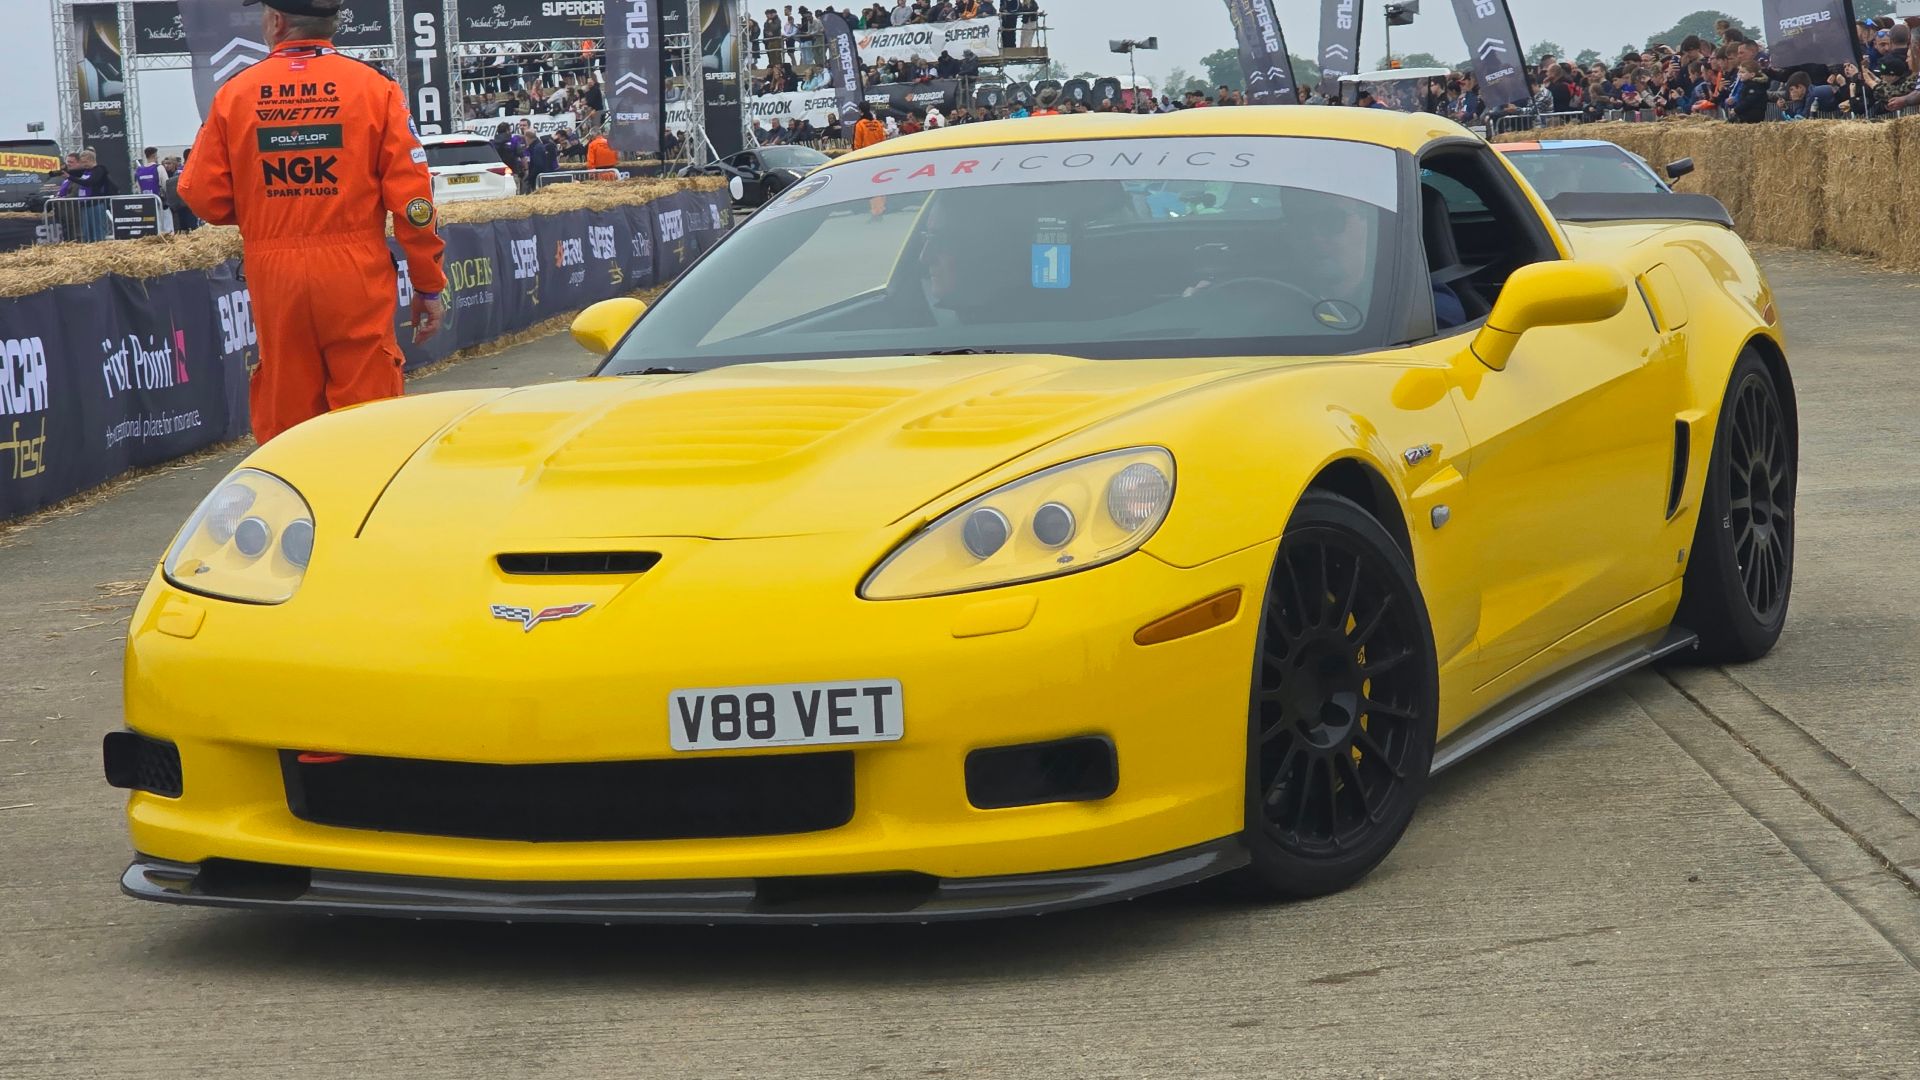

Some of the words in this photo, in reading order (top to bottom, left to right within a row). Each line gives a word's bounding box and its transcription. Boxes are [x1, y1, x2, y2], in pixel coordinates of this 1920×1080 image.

[944, 24, 990, 43] SUPERCAR
[83, 101, 122, 110] SUPERCAR
[256, 106, 340, 121] GINETTA
[270, 133, 328, 144] POLYFLOR
[262, 154, 338, 186] NGK
[266, 188, 301, 197] SPARK
[304, 187, 339, 196] PLUGS
[129, 334, 174, 390] Point
[0, 417, 46, 480] fest
[677, 693, 776, 743] V88
[792, 686, 893, 737] VET
